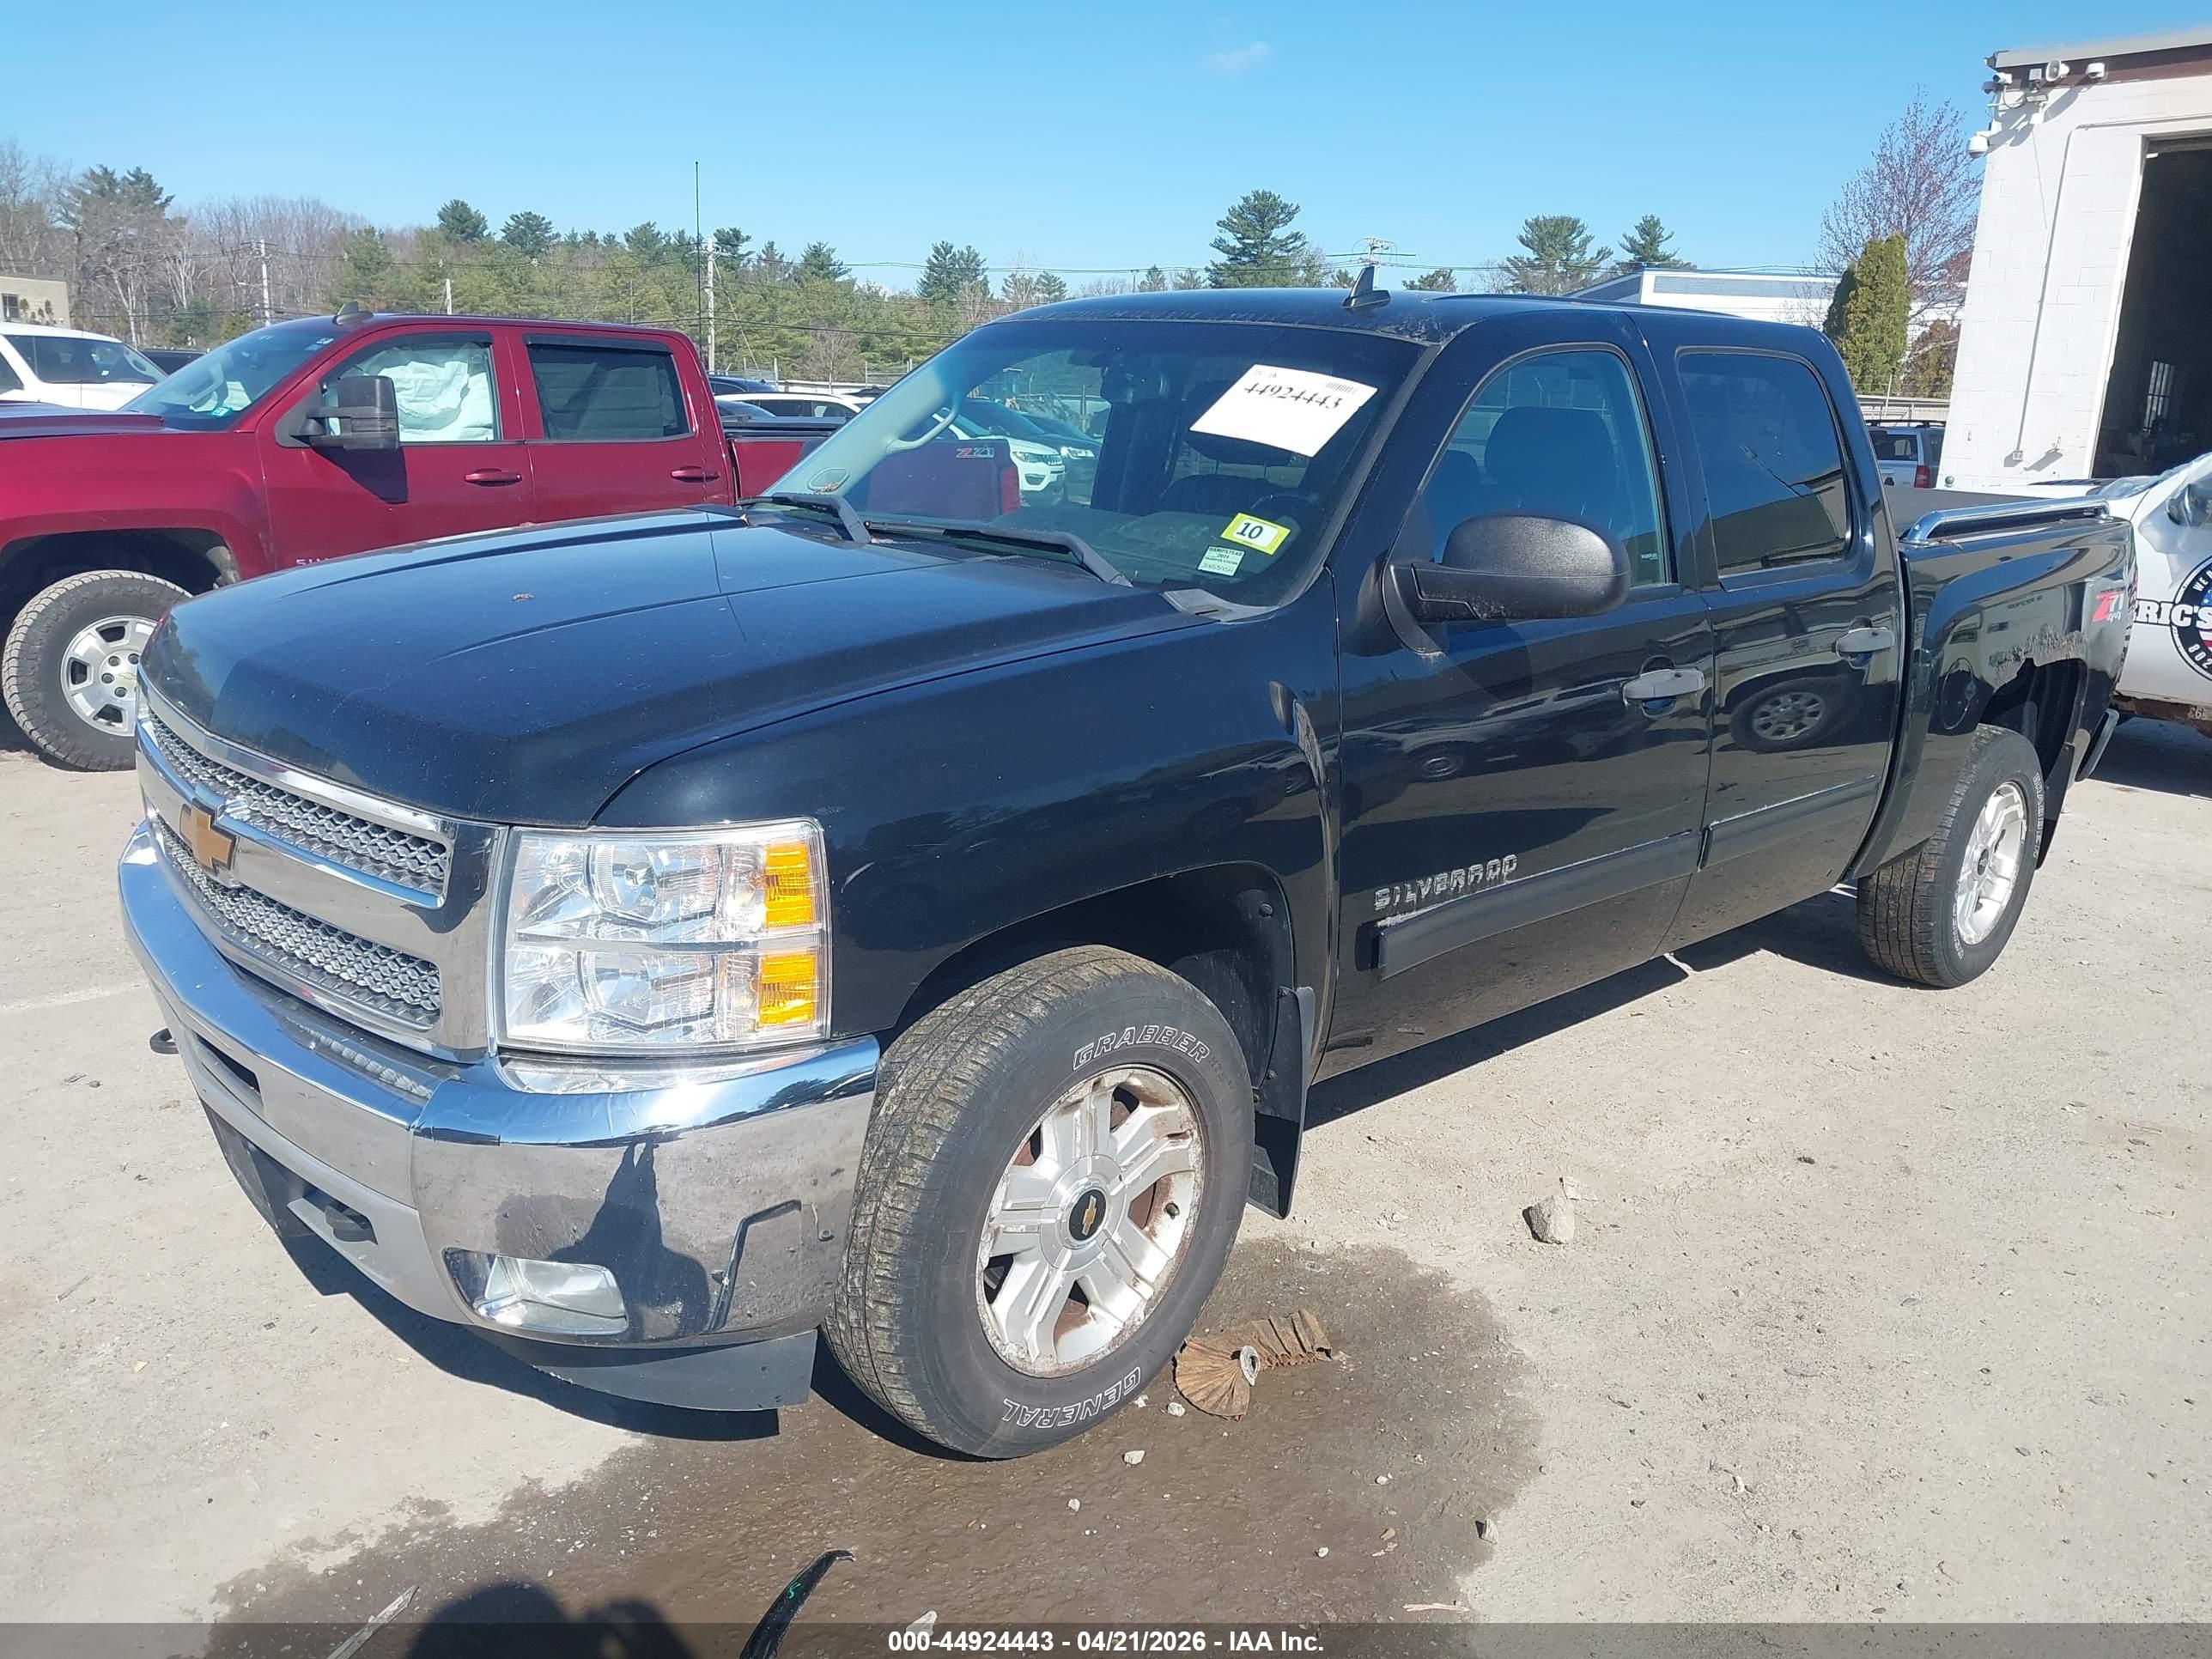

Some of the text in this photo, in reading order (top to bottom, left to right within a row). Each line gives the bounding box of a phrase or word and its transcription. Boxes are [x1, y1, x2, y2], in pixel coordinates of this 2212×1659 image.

[1244, 382, 1342, 409] 44924443
[956, 447, 995, 459] Z71
[1237, 521, 1264, 540] 10
[1210, 548, 1243, 556] HAMPSTEAD
[2192, 576, 2209, 592] WE
[2092, 590, 2125, 623] Z71
[2136, 599, 2212, 629] RIC'S
[1374, 854, 1518, 911] SILVERADO
[1073, 1024, 1211, 1071] GRABBER
[1002, 1366, 1141, 1429] GENERAL
